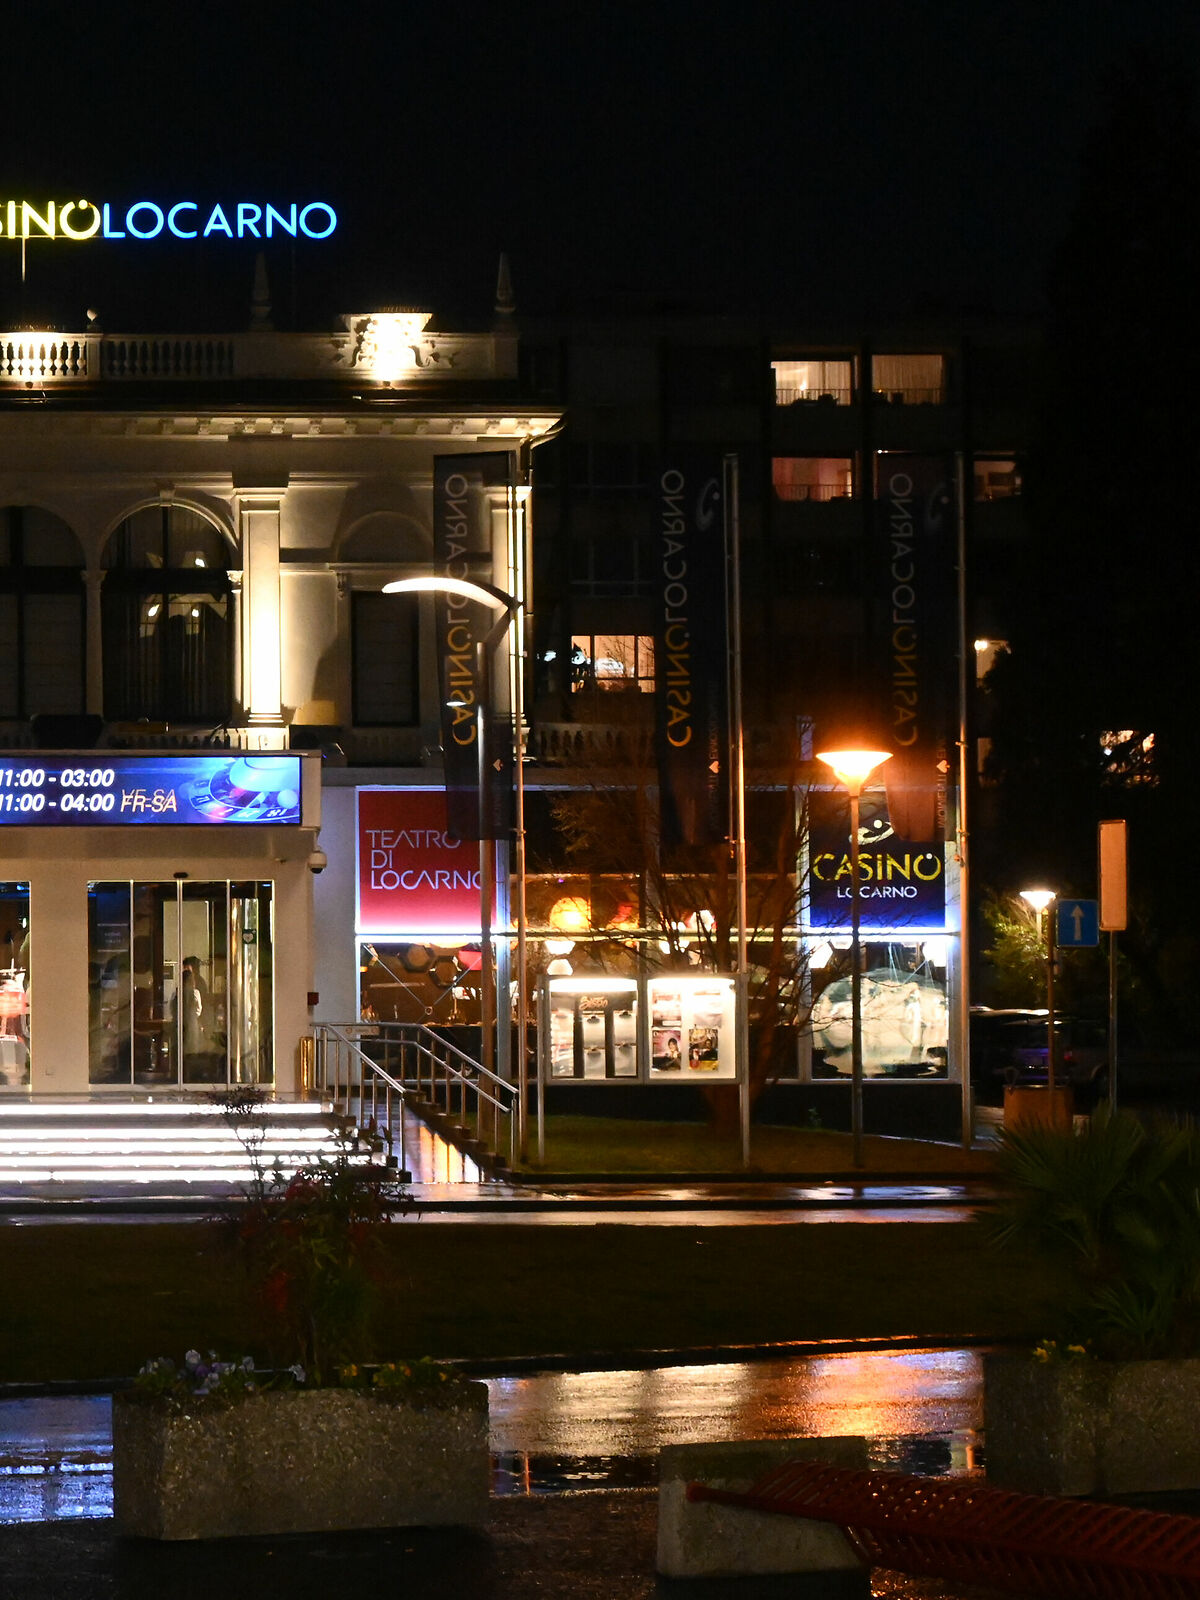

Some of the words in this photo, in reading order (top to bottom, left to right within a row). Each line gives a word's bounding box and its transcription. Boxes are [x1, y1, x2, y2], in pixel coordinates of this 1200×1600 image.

[60, 770, 114, 787] 03:00
[60, 795, 114, 812] 04:00
[371, 850, 393, 869] DI
